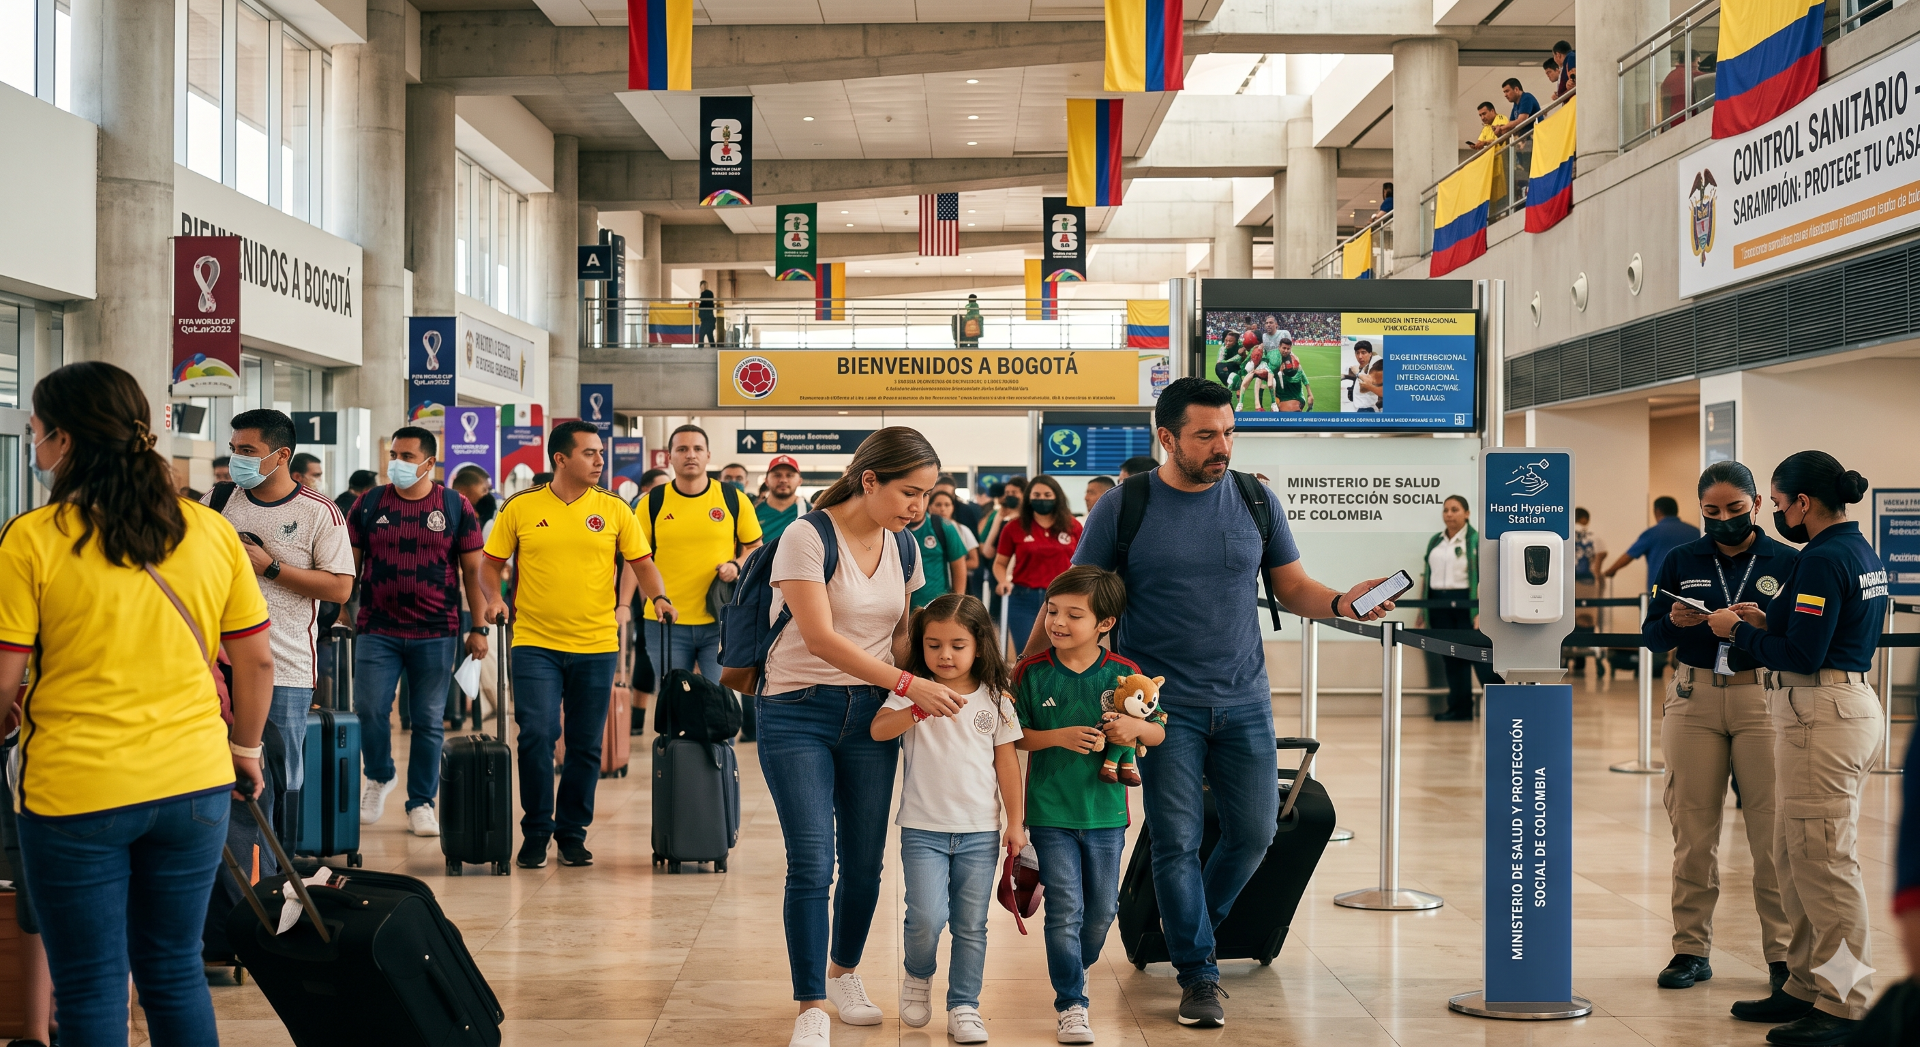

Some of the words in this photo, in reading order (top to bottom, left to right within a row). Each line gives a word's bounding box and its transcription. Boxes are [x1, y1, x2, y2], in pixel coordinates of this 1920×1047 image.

[1733, 121, 1804, 185] CONTROL
[1809, 70, 1908, 153] SANITARIO
[1733, 171, 1801, 226] SARAMPIÓN:
[1804, 148, 1862, 199] PROTEGE
[1864, 140, 1882, 175] TU
[586, 253, 601, 267] A
[292, 257, 301, 301] A
[305, 266, 352, 319] BOGOTÁ
[837, 356, 973, 375] BIENVENIDOS
[978, 357, 992, 375] A
[997, 352, 1078, 375] BOGOTÁ
[309, 416, 320, 441] 1
[1287, 477, 1369, 488] MINISTERIO
[1373, 477, 1391, 488] DE
[1395, 477, 1441, 488] SALUD
[1287, 493, 1297, 505] Y
[1300, 490, 1389, 505] PROTECCIÓN
[1393, 493, 1443, 505] SOCIAL
[1490, 503, 1518, 513] Hand
[1521, 503, 1564, 515] Hygiene
[1287, 510, 1306, 521] DE
[1310, 509, 1383, 521] COLOMBIA
[1509, 718, 1523, 803] PROTECCIÓN
[1511, 805, 1523, 815] Y
[1534, 766, 1546, 837] COLOMBIA
[1511, 818, 1523, 860] SALUD
[1534, 840, 1546, 857] DE
[1511, 863, 1523, 880] DE
[1534, 859, 1546, 907] SOCIAL
[1511, 883, 1523, 960] MINISTERIO
